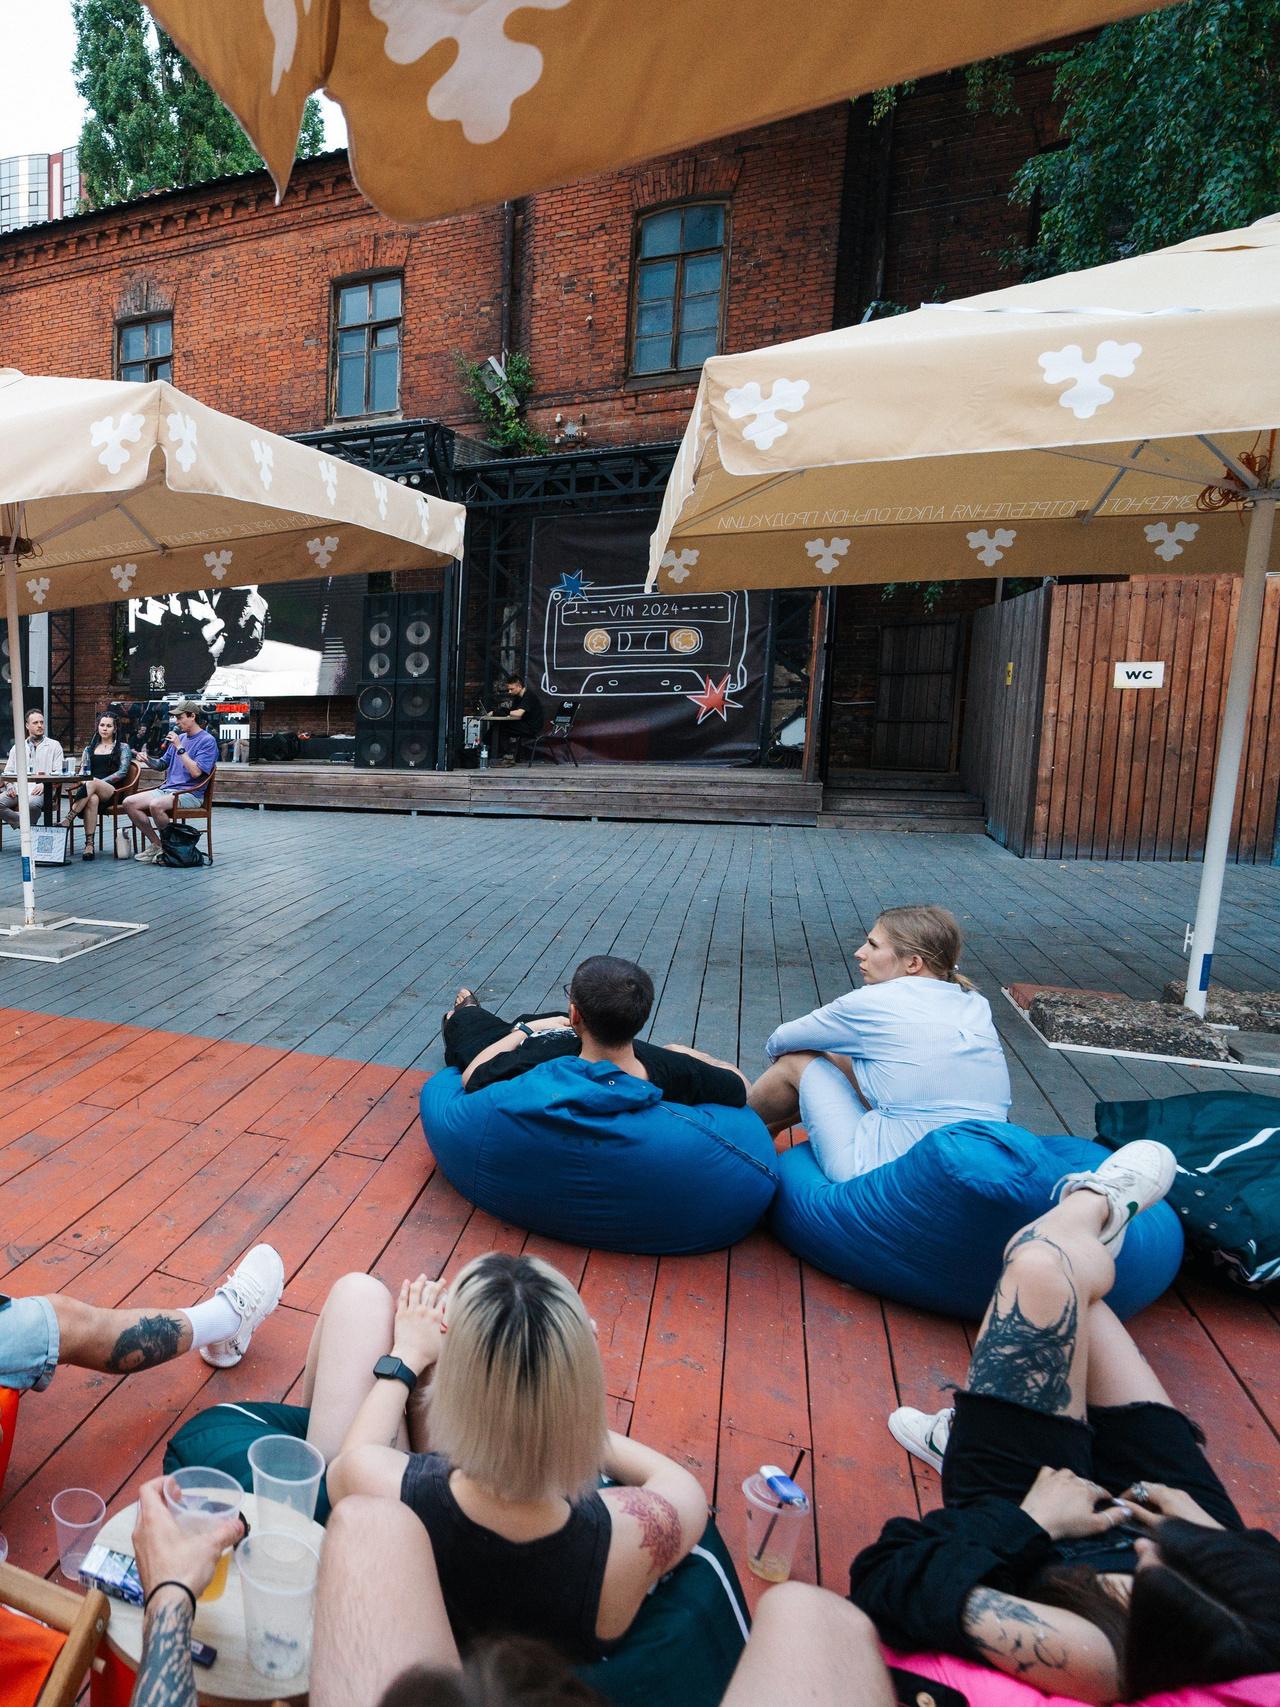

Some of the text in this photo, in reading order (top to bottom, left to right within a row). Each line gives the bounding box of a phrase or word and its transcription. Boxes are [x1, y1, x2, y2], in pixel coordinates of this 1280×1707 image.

[607, 602, 679, 617] VIN 2024
[1125, 670, 1153, 680] WC
